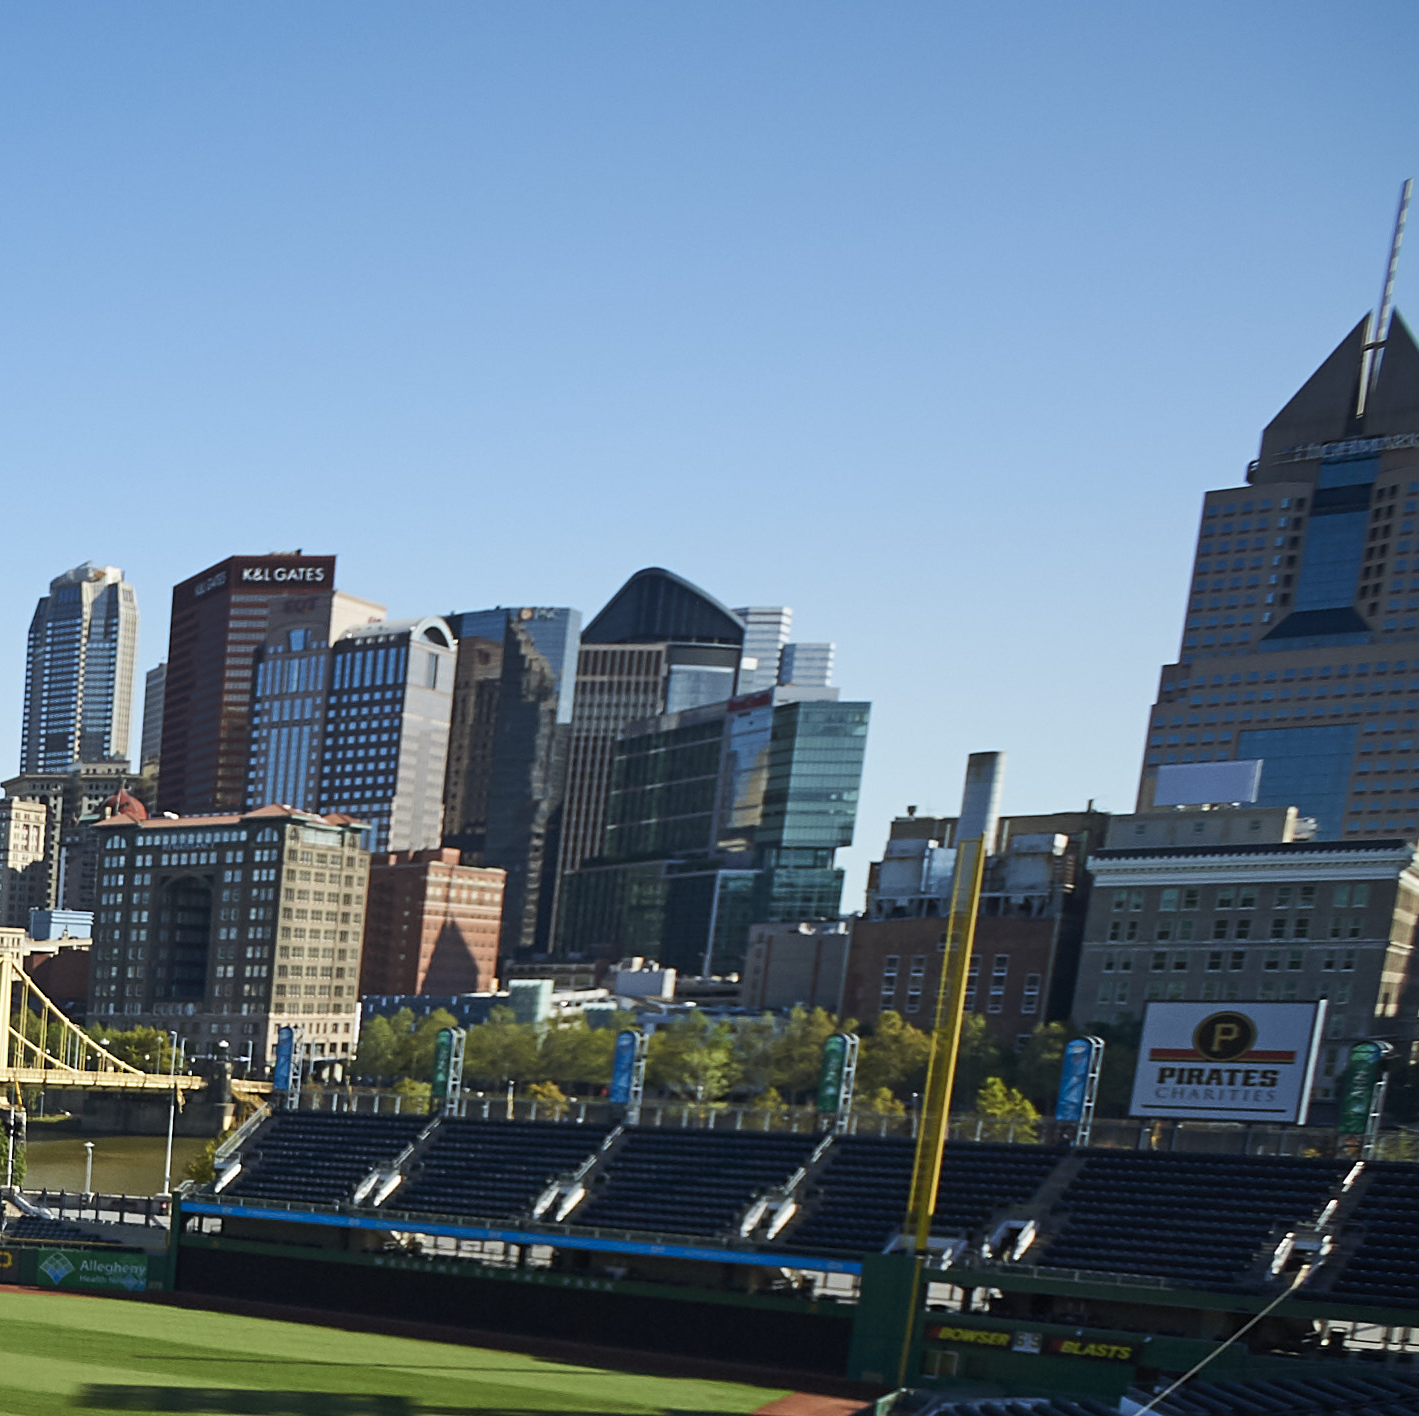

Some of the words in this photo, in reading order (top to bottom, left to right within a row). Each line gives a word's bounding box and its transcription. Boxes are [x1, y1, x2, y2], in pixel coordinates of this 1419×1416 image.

[241, 567, 271, 582] K&L
[273, 567, 325, 582] GATES
[1156, 1066, 1279, 1087] PIRATES
[1154, 1087, 1278, 1102] CHARITIES
[79, 1259, 147, 1274] Allegheny
[939, 1326, 1011, 1347] BOWSER
[1060, 1339, 1132, 1360] BLASTS
